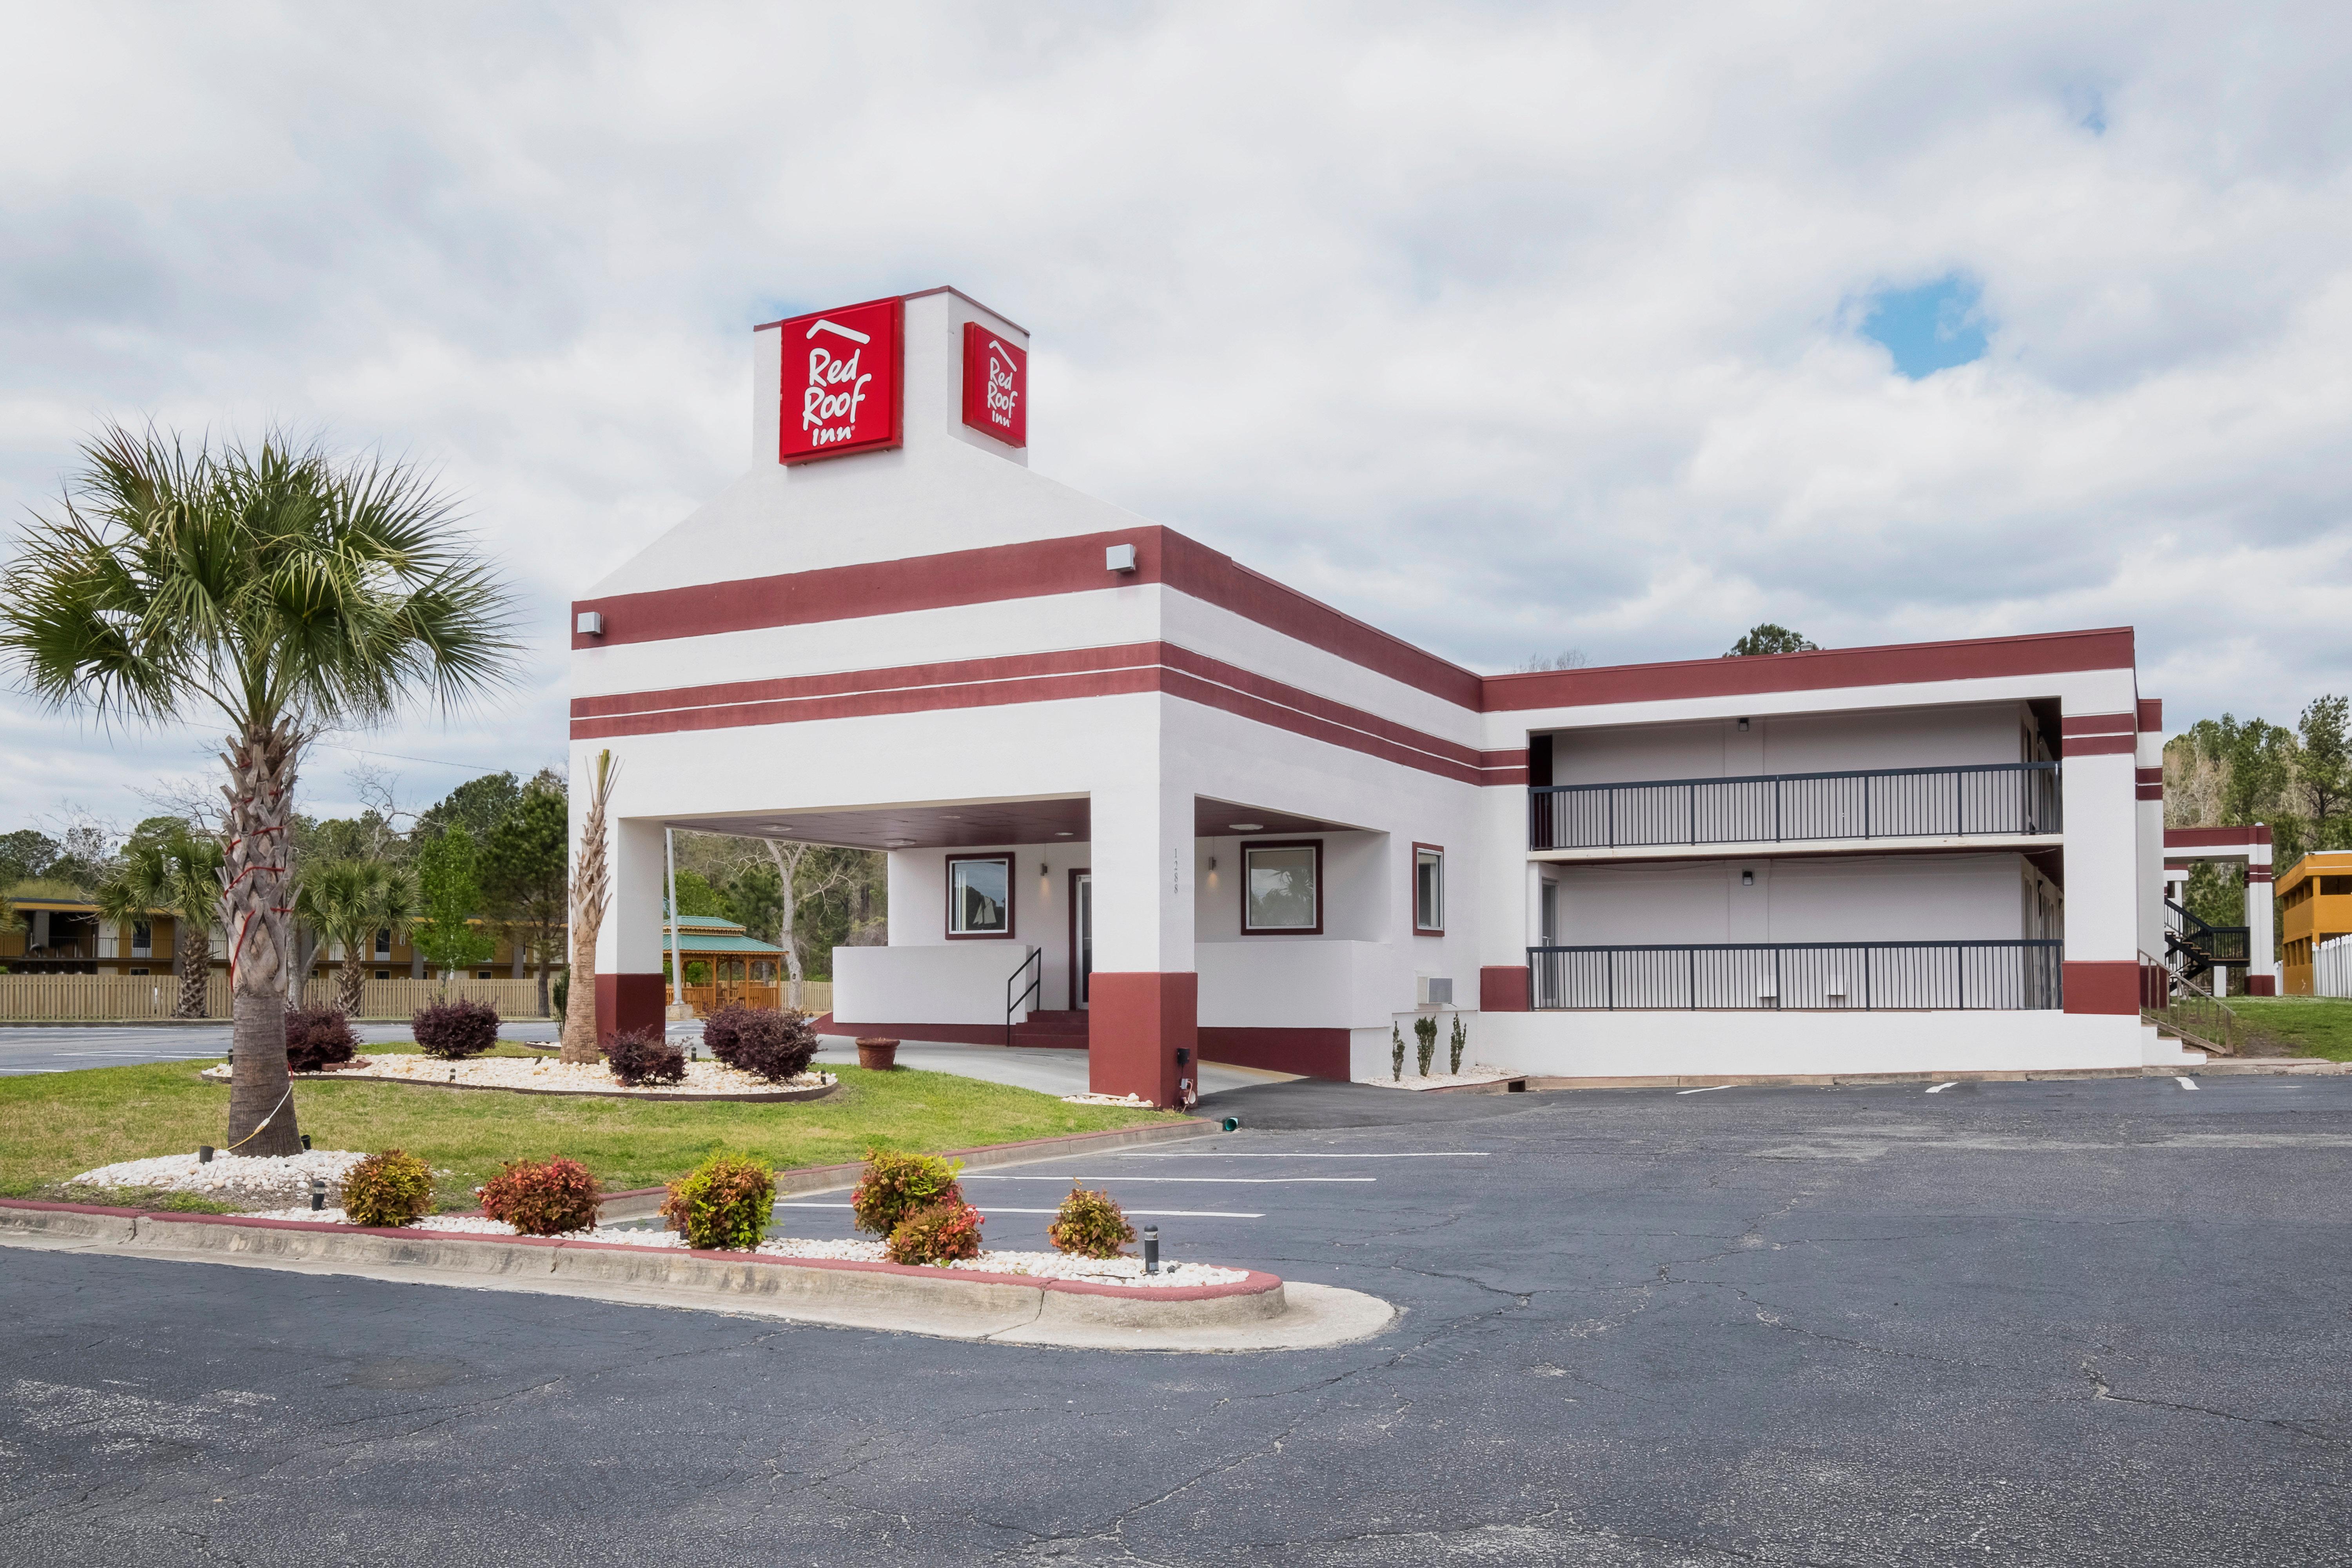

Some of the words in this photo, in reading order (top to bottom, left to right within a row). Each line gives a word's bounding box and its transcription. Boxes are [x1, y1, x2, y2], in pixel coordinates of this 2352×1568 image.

[809, 348, 860, 387] Red
[990, 357, 1013, 391] Red
[802, 373, 872, 431] Roof
[987, 381, 1018, 419] Roof
